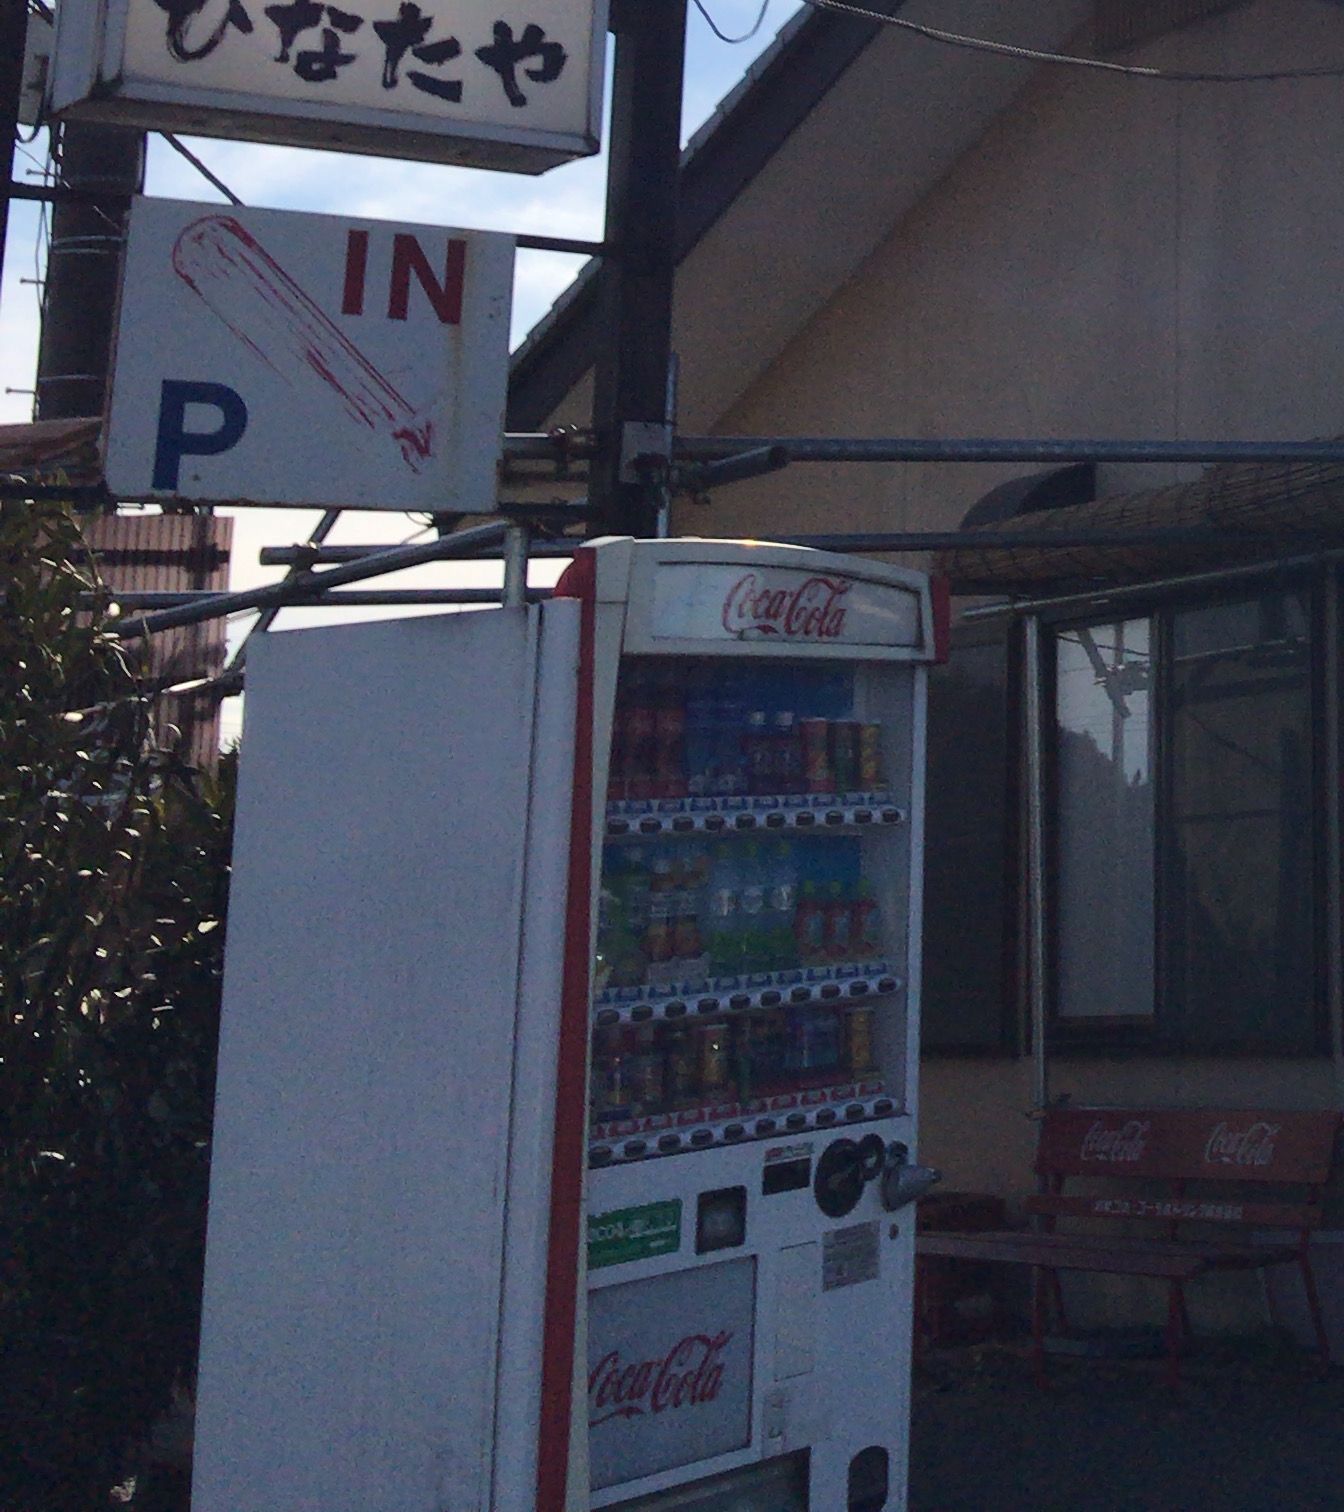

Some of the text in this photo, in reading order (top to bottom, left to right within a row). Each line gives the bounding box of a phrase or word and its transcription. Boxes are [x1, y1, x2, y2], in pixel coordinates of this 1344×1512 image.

[341, 229, 467, 325] IN
[151, 379, 249, 488] P
[723, 574, 850, 638] Coca-Cola
